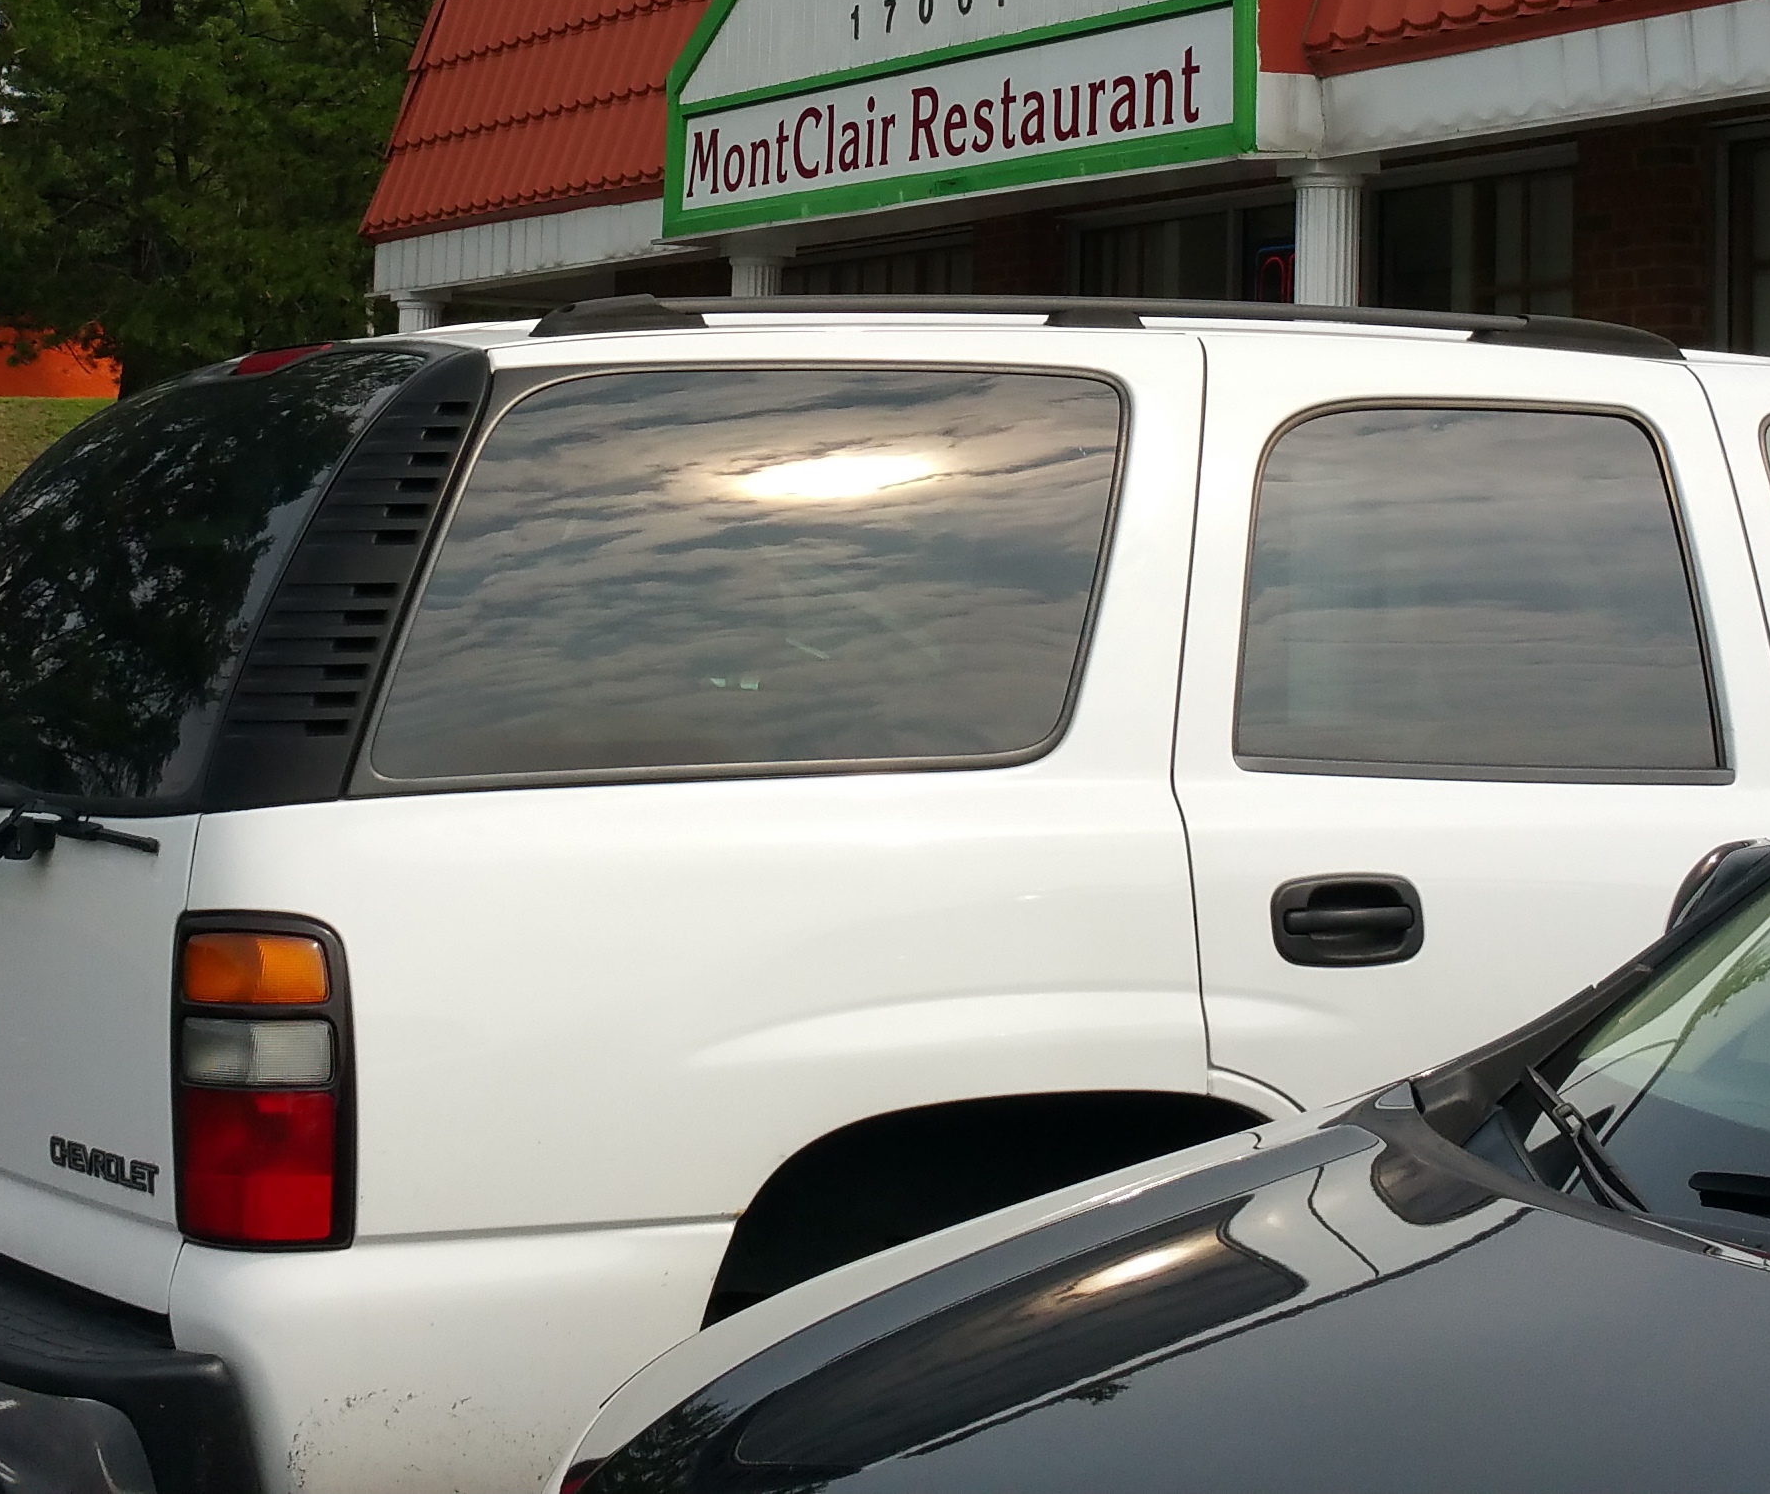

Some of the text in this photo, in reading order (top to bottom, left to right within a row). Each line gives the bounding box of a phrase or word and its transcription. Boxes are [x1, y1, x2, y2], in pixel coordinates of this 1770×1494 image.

[686, 46, 1200, 198] MontClair Restaurant
[50, 1135, 159, 1196] CHEVROLET
